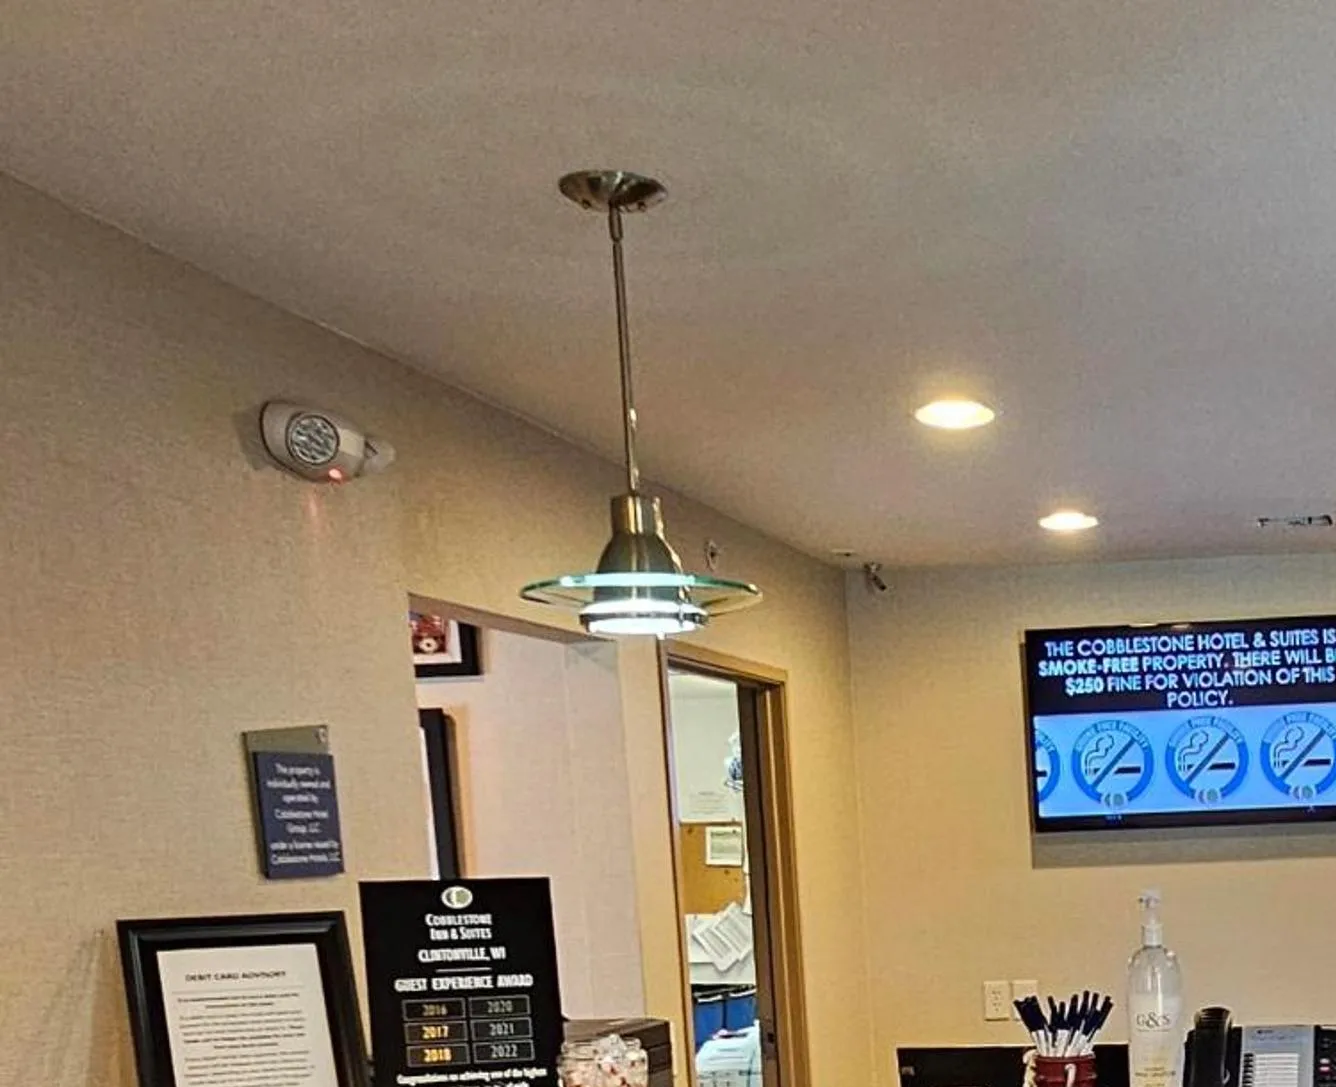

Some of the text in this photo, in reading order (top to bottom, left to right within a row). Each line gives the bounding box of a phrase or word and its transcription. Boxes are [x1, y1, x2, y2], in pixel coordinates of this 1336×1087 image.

[1044, 641, 1074, 657] THE
[1077, 635, 1194, 656] COBBLESTONE
[1196, 632, 1249, 650] HOTEL
[1252, 632, 1267, 648] &
[1269, 629, 1319, 647] SUITES
[1323, 628, 1336, 644] IS
[1038, 656, 1140, 677] SMOKE-FREE
[1142, 652, 1229, 672] PROPERTY.
[1232, 650, 1281, 668] THERE
[1284, 648, 1322, 665] WILL
[1065, 666, 1336, 697] $250 FINE FOR VIOLATION OF THIS
[1166, 689, 1234, 708] POLICY.
[422, 1025, 449, 1039] 2017
[489, 1022, 515, 1037] 2021
[491, 1044, 519, 1058] 2022
